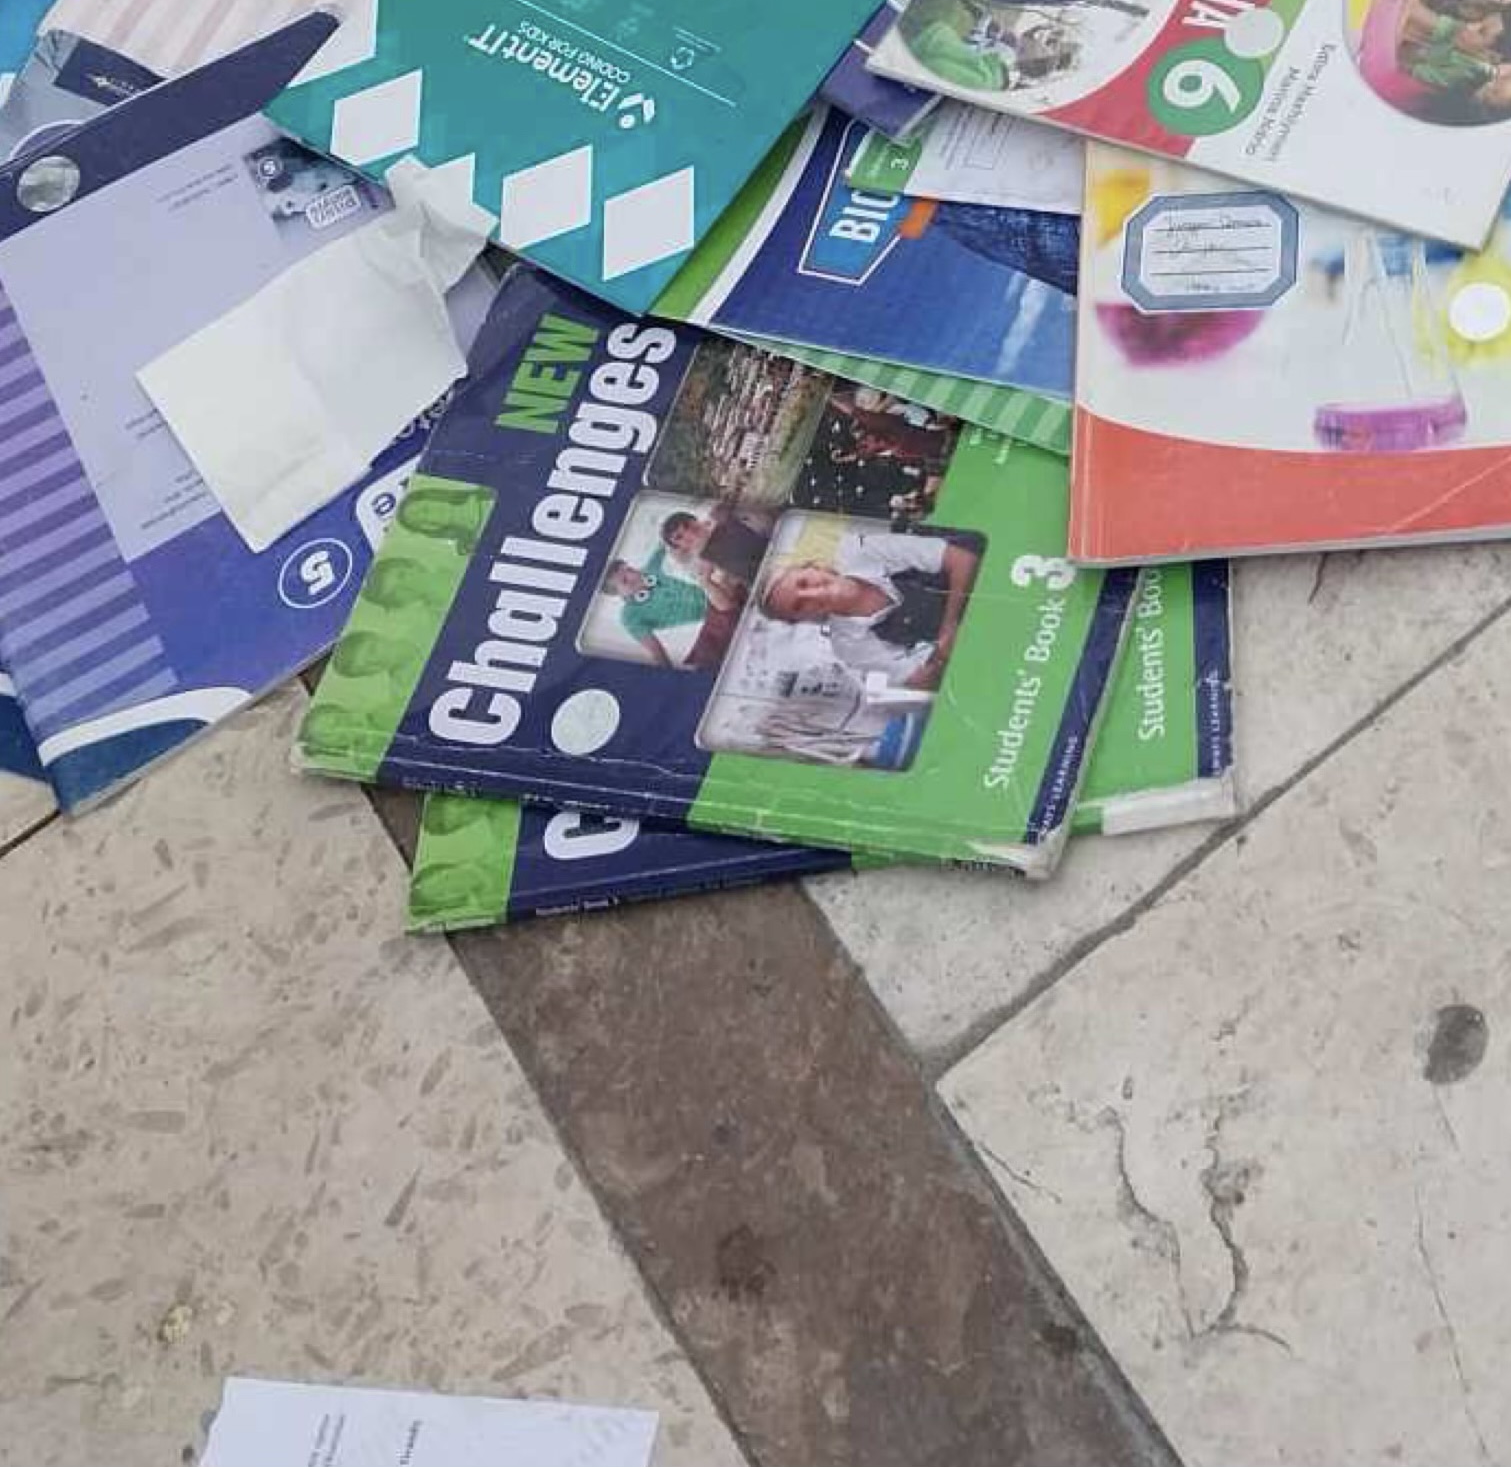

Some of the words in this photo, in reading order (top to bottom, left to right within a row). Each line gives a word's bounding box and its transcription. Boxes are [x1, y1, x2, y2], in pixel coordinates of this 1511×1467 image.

[468, 23, 621, 115] ElementIT
[495, 313, 602, 436] NEW
[428, 320, 679, 747] Challenges
[1010, 553, 1077, 591] 3
[1023, 593, 1066, 664] Book
[1137, 623, 1166, 742] Students'
[983, 670, 1042, 790] Students'
